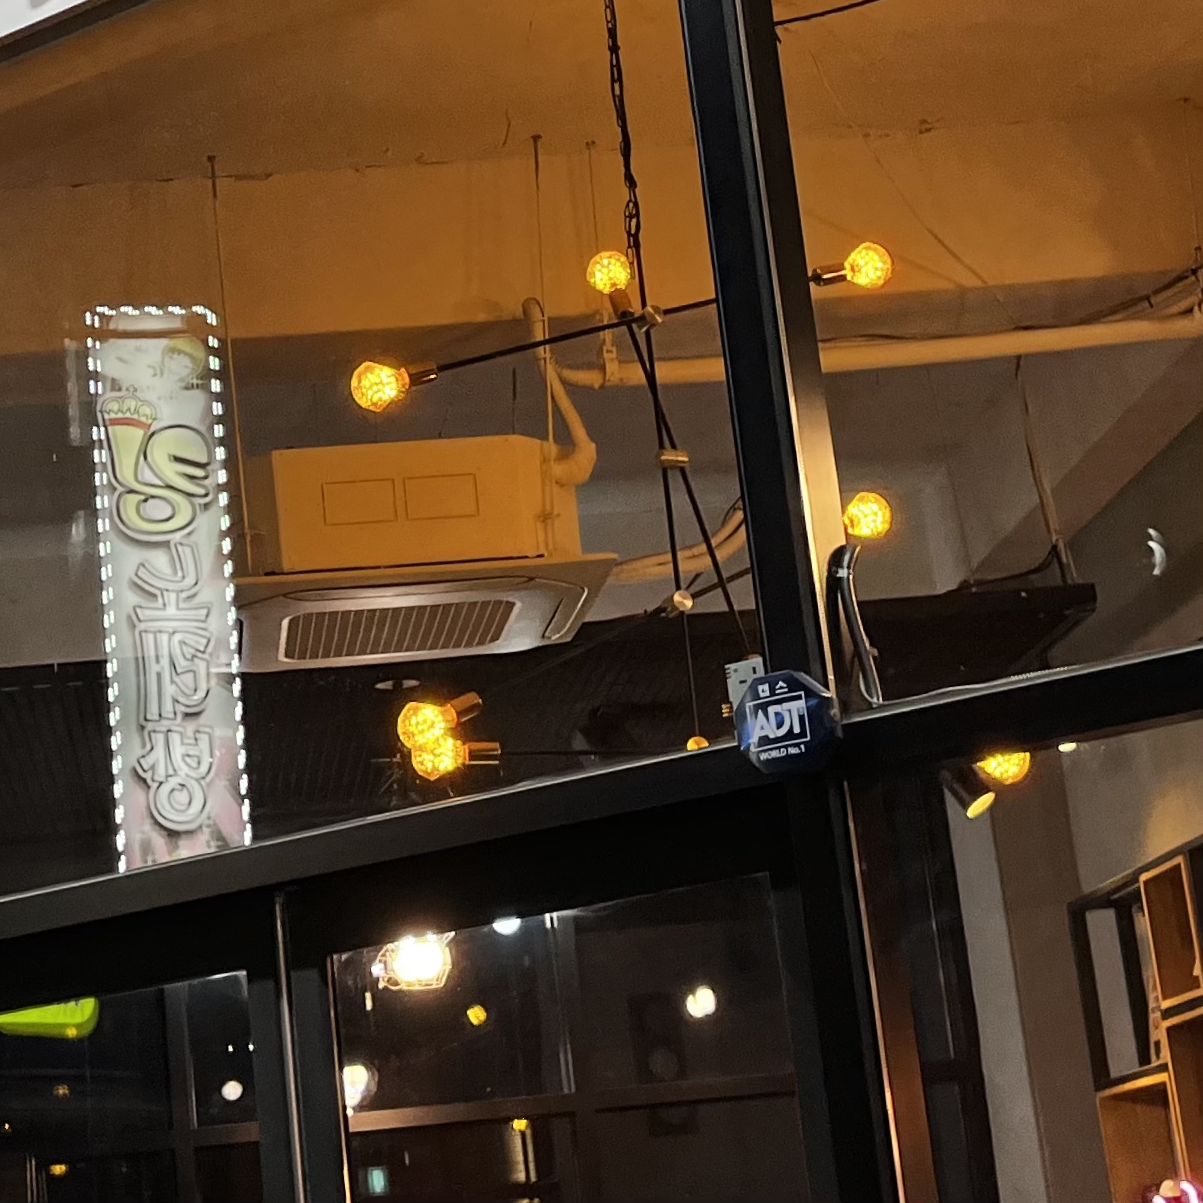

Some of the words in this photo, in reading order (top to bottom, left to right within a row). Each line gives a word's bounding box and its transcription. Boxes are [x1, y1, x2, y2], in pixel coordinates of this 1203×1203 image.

[752, 700, 805, 746] ADT
[759, 748, 787, 761] WORLD
[787, 744, 806, 755] No.1
